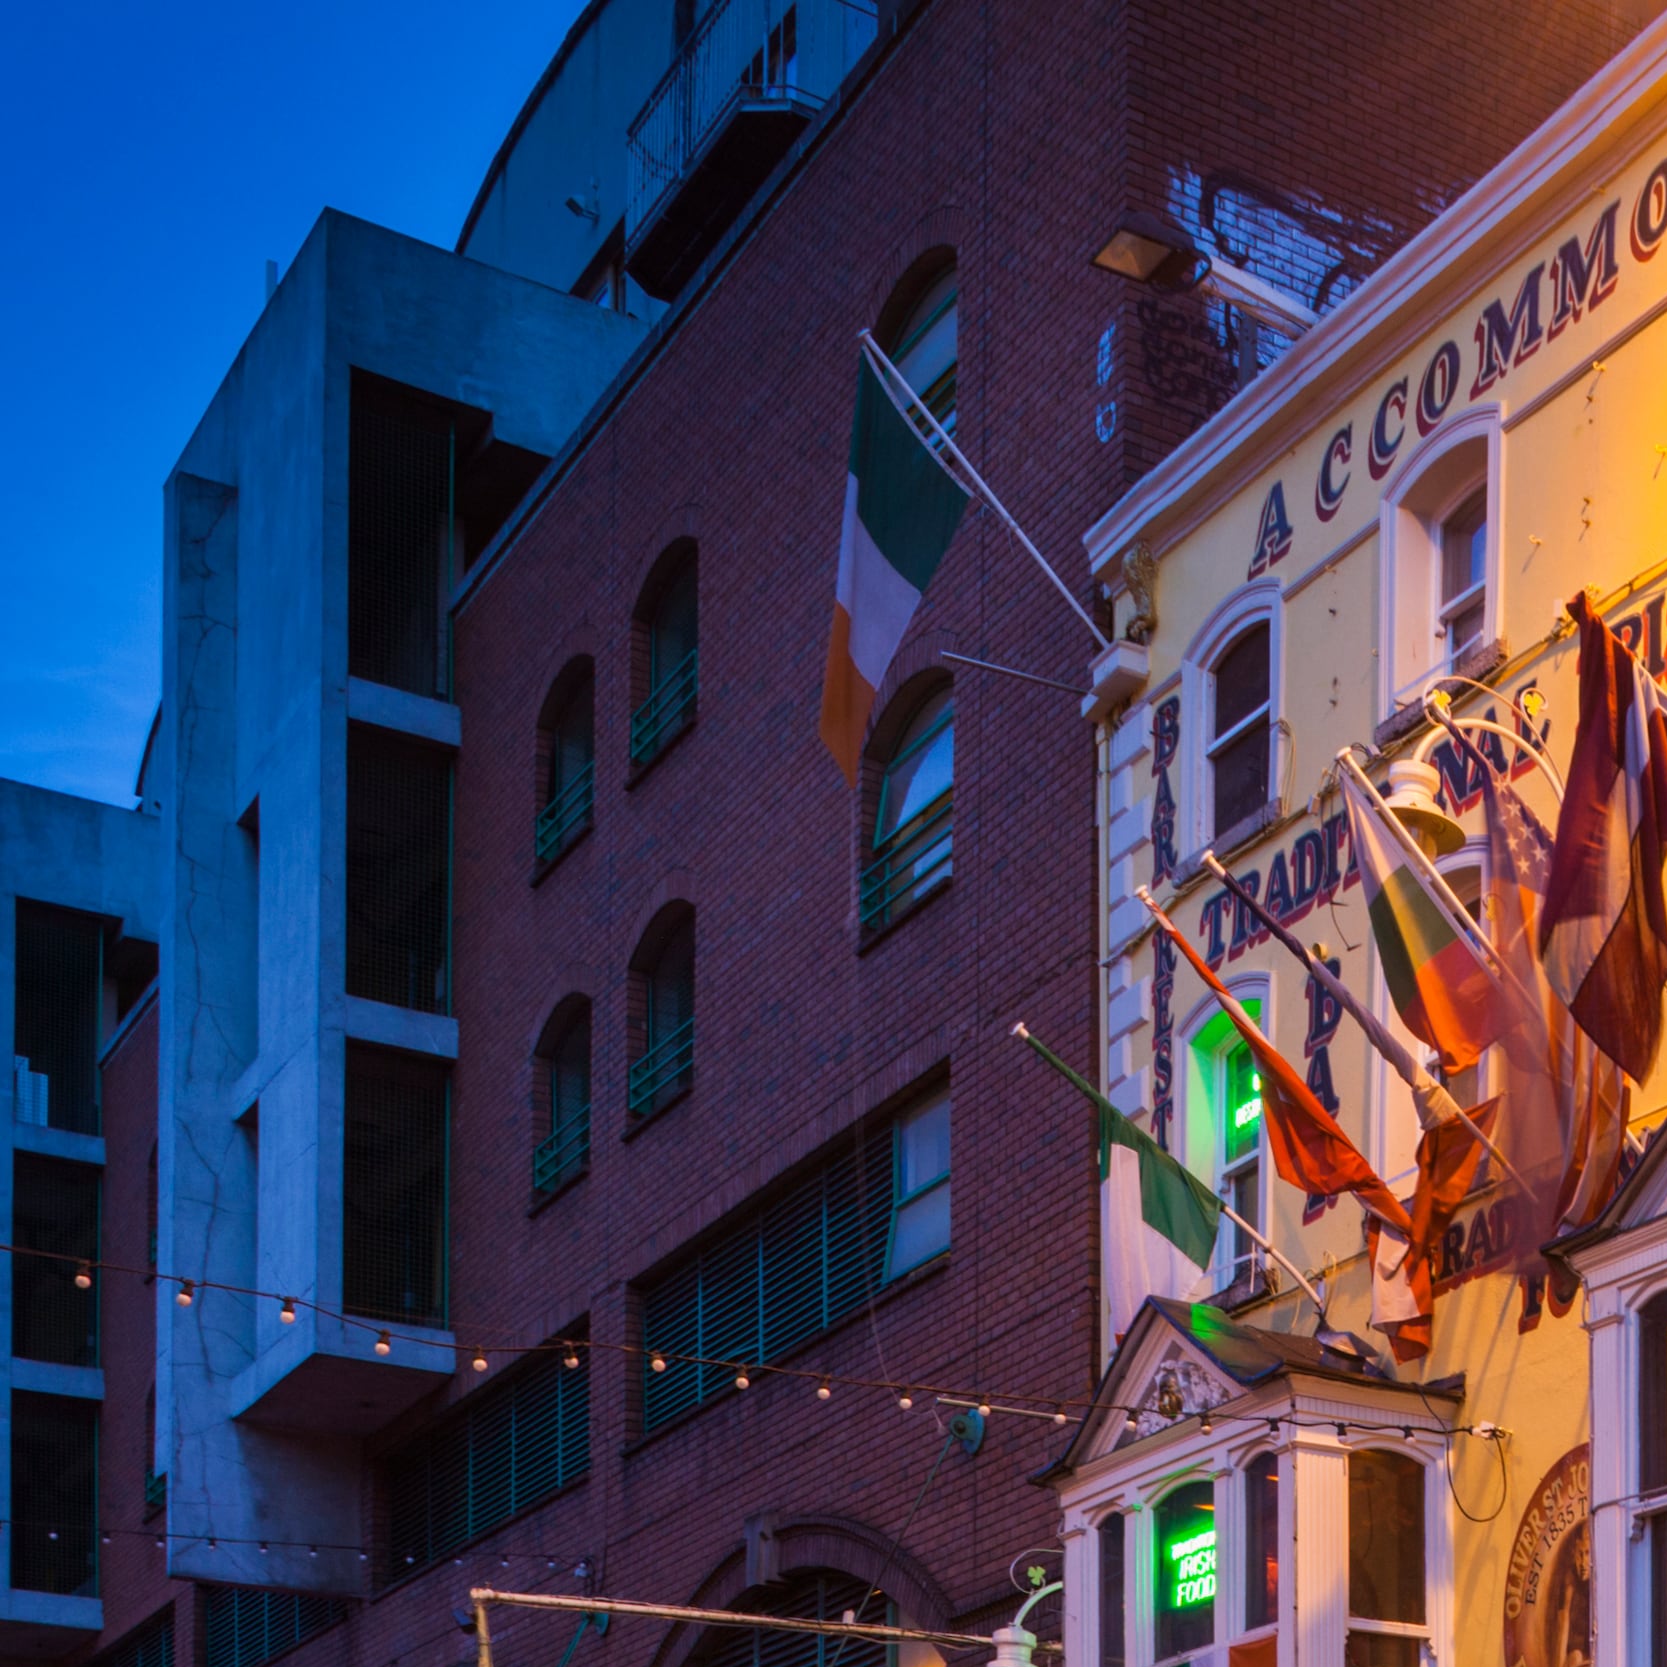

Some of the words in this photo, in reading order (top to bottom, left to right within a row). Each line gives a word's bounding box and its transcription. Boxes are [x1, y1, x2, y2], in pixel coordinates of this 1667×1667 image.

[1152, 695, 1180, 889] BAR
[1506, 1506, 1547, 1620] OLIVER
[1542, 1477, 1564, 1514] ST
[1567, 1461, 1589, 1499] JO
[1525, 1553, 1542, 1606] EST
[1542, 1504, 1575, 1551] 1835
